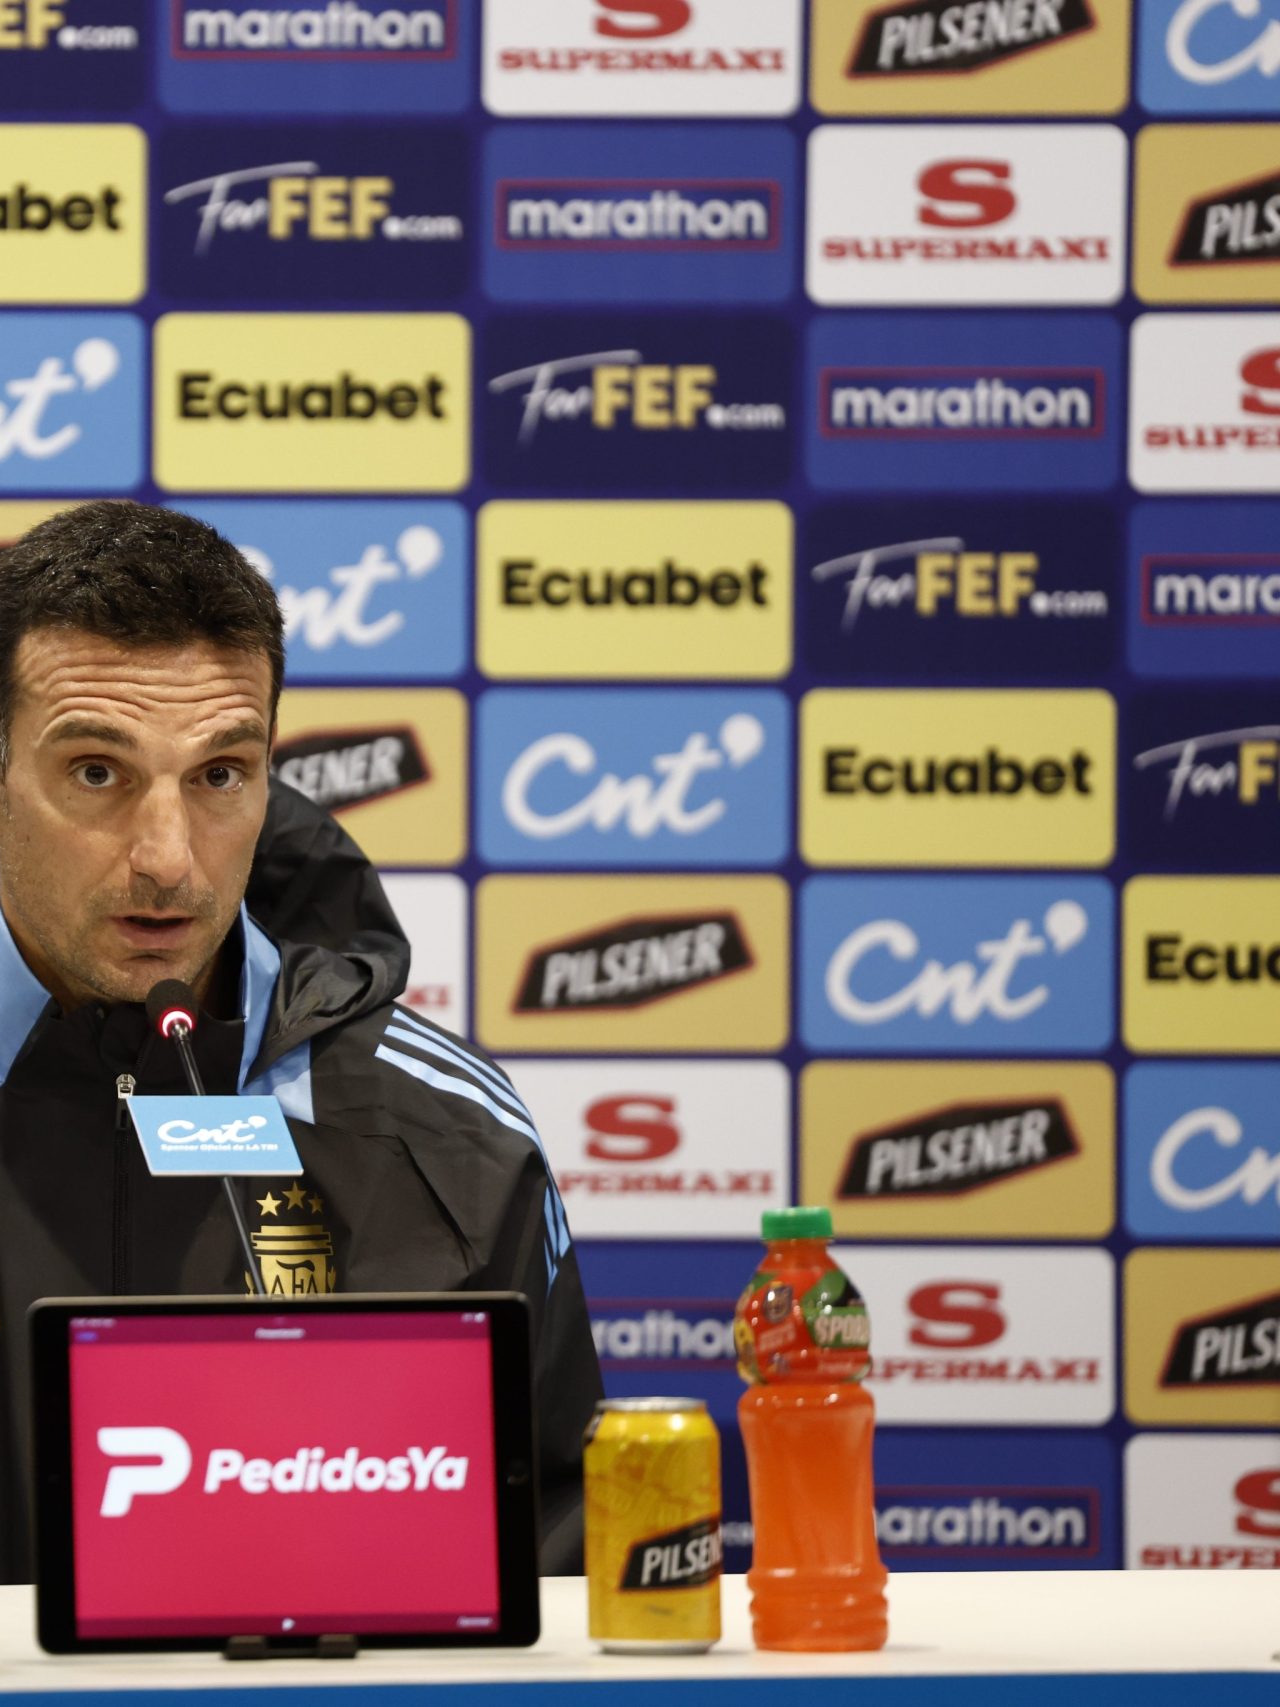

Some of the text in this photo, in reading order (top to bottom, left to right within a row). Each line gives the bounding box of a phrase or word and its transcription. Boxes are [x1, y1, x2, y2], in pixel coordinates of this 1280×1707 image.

[184, 2, 445, 49] marathon
[876, 0, 1062, 69] PILSENER
[498, 48, 784, 73] SUPERMAXI
[508, 190, 768, 239] marathon
[1200, 190, 1280, 259] PILS
[821, 236, 1111, 262] SUPERMAXI
[176, 370, 447, 420] Ecuabet
[831, 378, 1092, 428] marathon
[500, 558, 770, 608] Ecuabet
[824, 746, 1093, 797] Ecuabet
[540, 923, 727, 1008] PILSENER
[866, 1108, 1050, 1193] PILSENER
[557, 1169, 776, 1196] PERMAXI
[870, 1358, 1100, 1385] PERMAXI
[1191, 1314, 1280, 1381] PILS
[204, 1446, 469, 1494] PedidosYa
